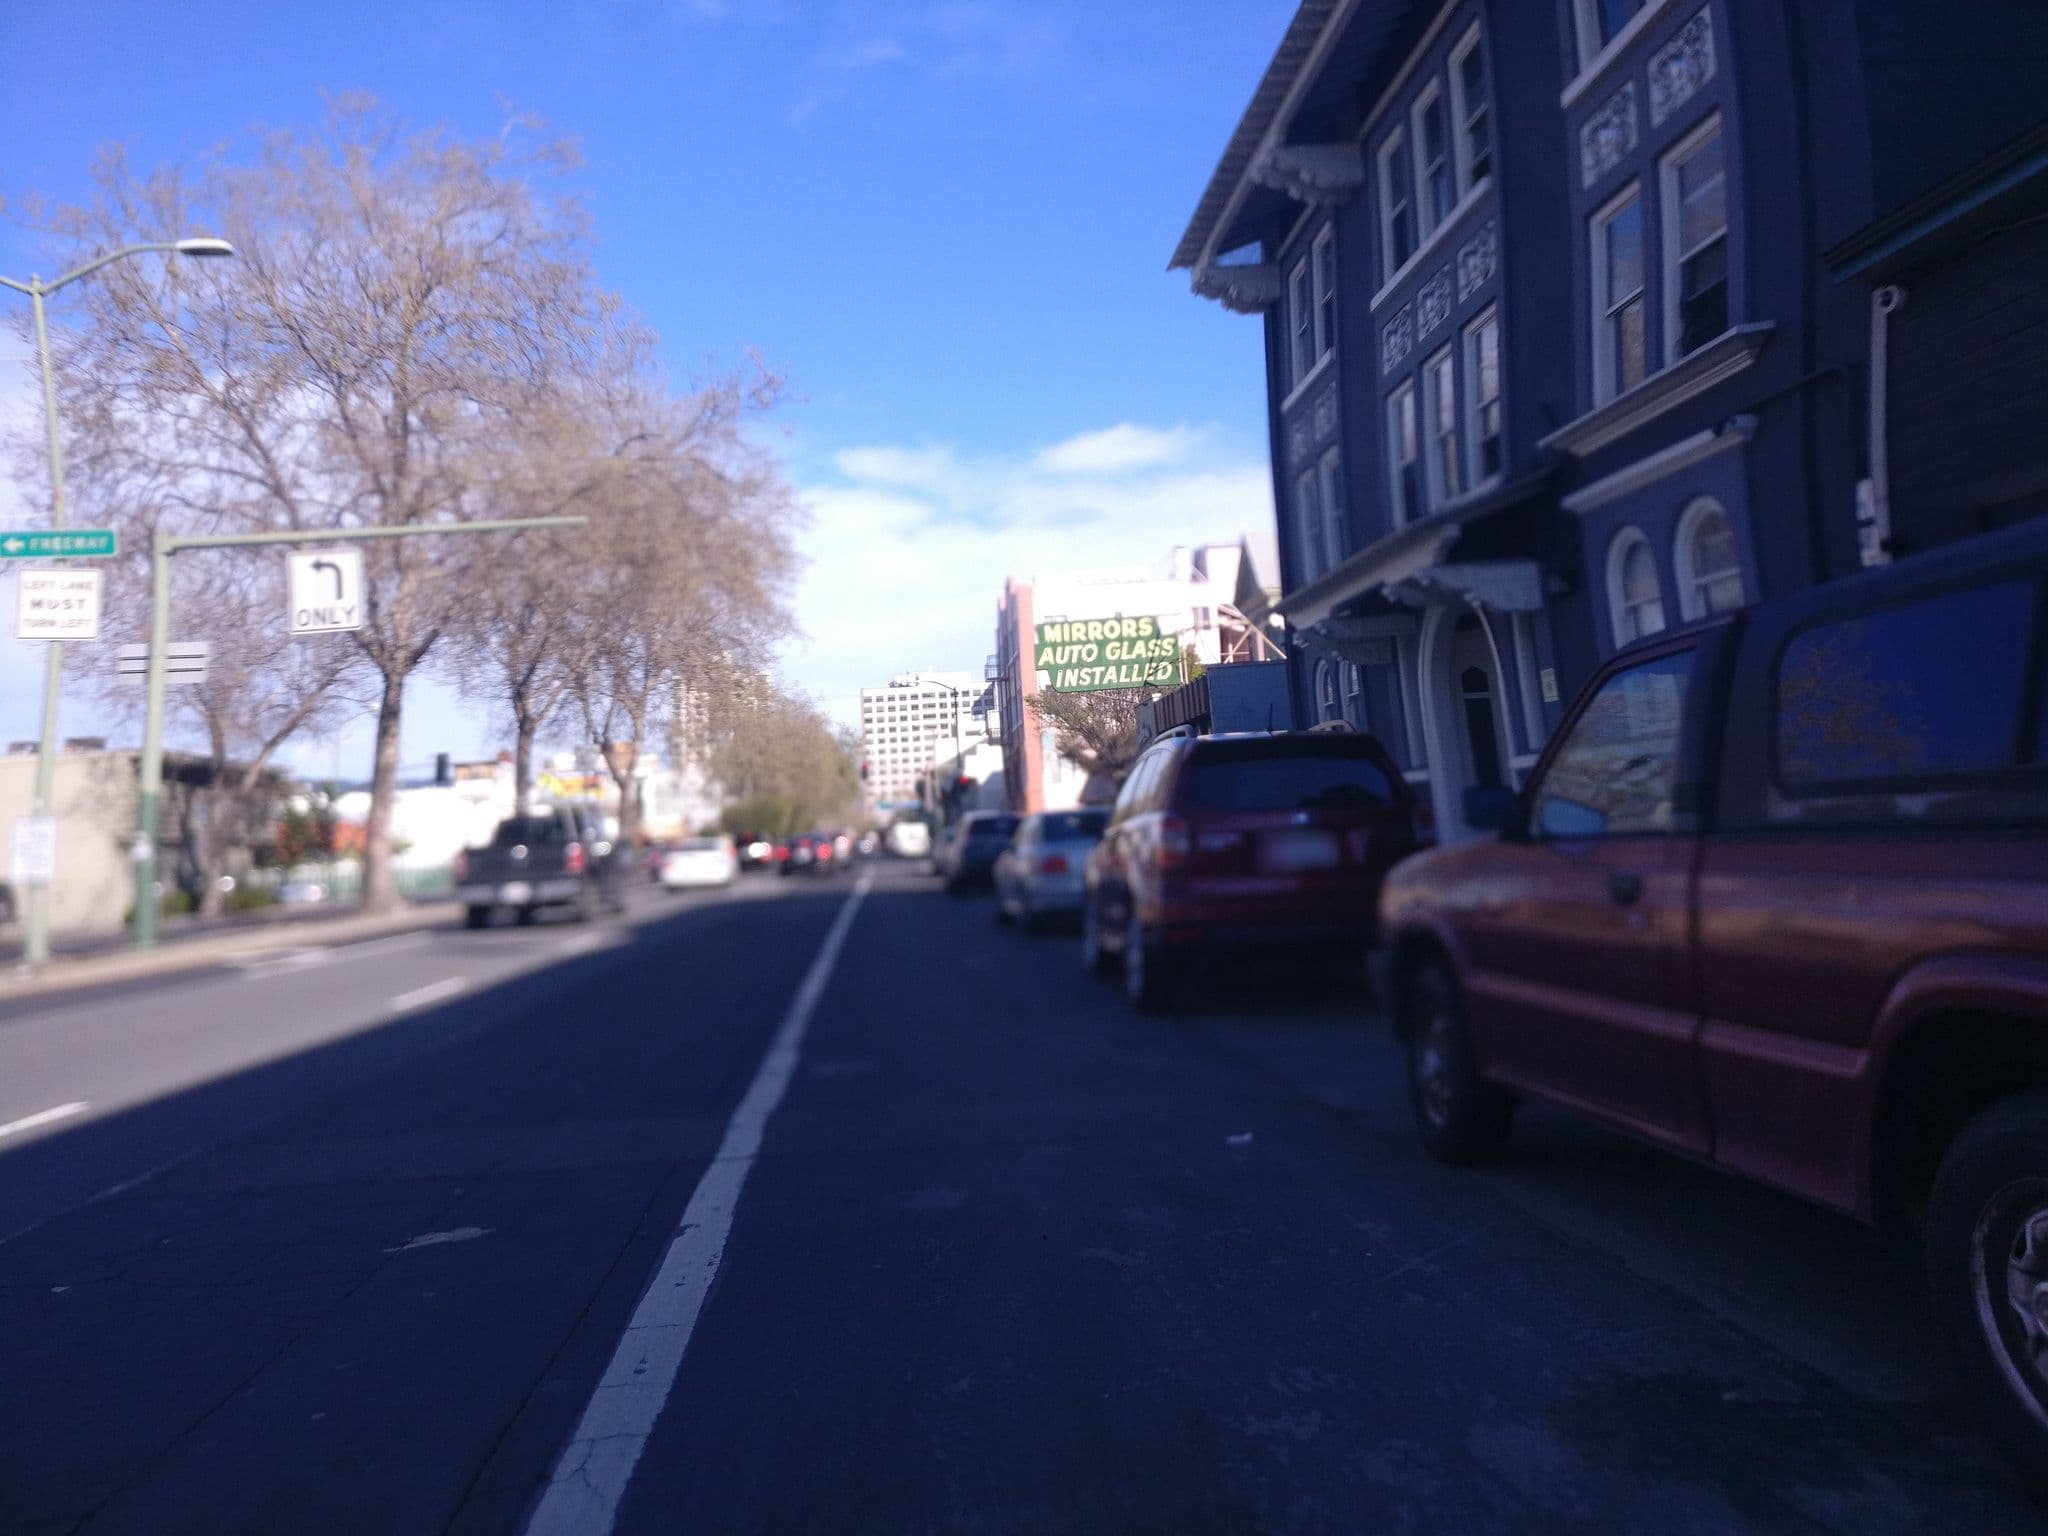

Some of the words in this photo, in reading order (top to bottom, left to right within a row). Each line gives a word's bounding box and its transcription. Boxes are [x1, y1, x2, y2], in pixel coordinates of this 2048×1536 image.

[30, 598, 87, 611] MUST
[296, 605, 356, 627] ONLY
[1043, 616, 1153, 643] MIRRORS
[1038, 643, 1098, 666] AUTO
[1105, 637, 1176, 660] GLASS
[1056, 661, 1173, 688] INSTALLED
